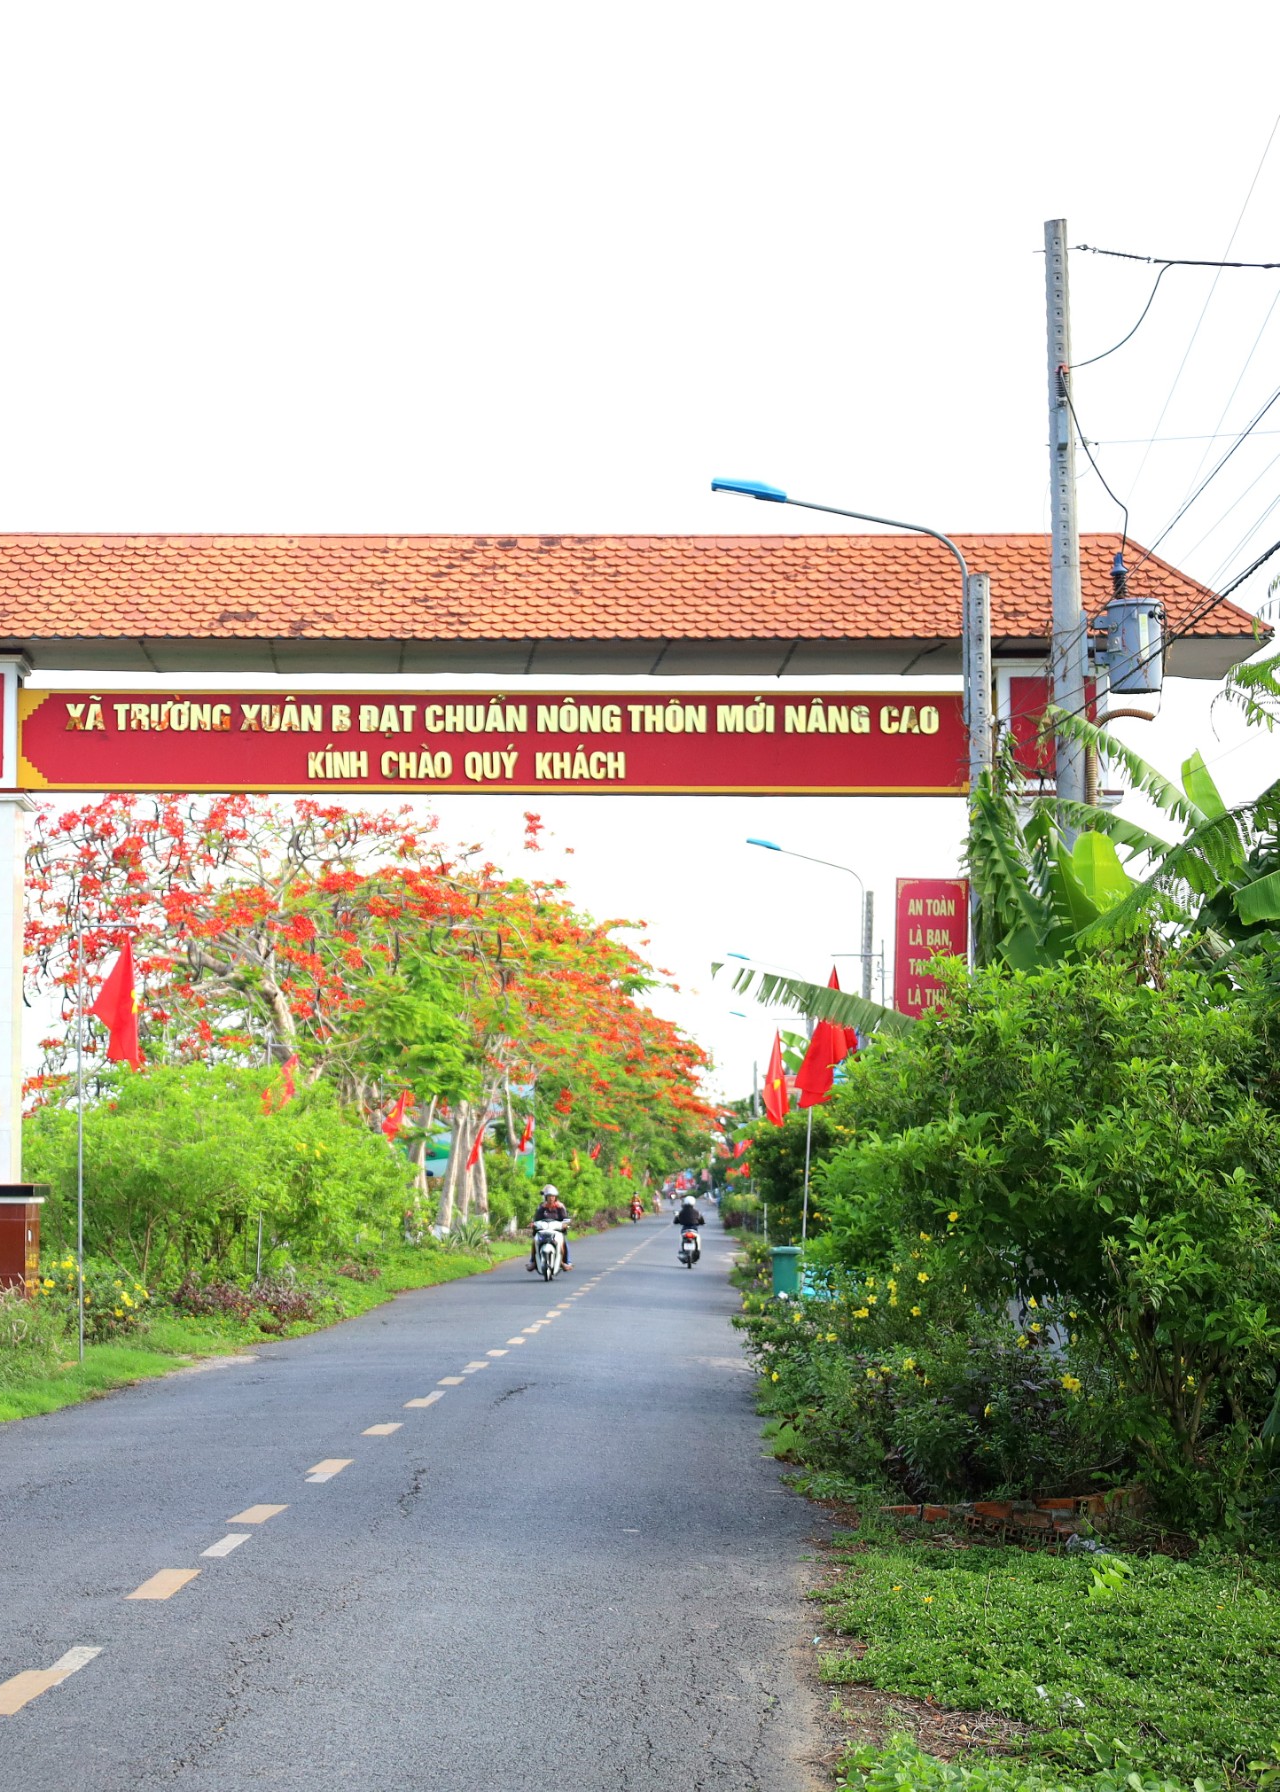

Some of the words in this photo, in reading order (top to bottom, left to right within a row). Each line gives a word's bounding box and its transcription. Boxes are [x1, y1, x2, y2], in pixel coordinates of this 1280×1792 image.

[65, 695, 106, 731] XÃ
[113, 694, 232, 732] TRƯỜNG
[240, 696, 322, 732] XUÂN
[331, 704, 351, 732] B
[359, 704, 417, 738] ĐẠT
[425, 693, 528, 733] CHUẨN
[536, 697, 622, 733] NÔNG
[627, 698, 707, 733] THÔN
[716, 696, 775, 734] MỚI
[784, 697, 870, 734] NÂNG
[880, 705, 940, 735] CAO
[307, 743, 368, 778] KÍNH
[381, 743, 453, 779] CHÀO
[464, 743, 519, 782] QUÝ
[535, 744, 626, 779] KHÁCH
[907, 898, 923, 916] AN
[925, 894, 955, 916] TOÀN
[908, 923, 923, 946] LÀ
[907, 983, 922, 1006] LÀ
